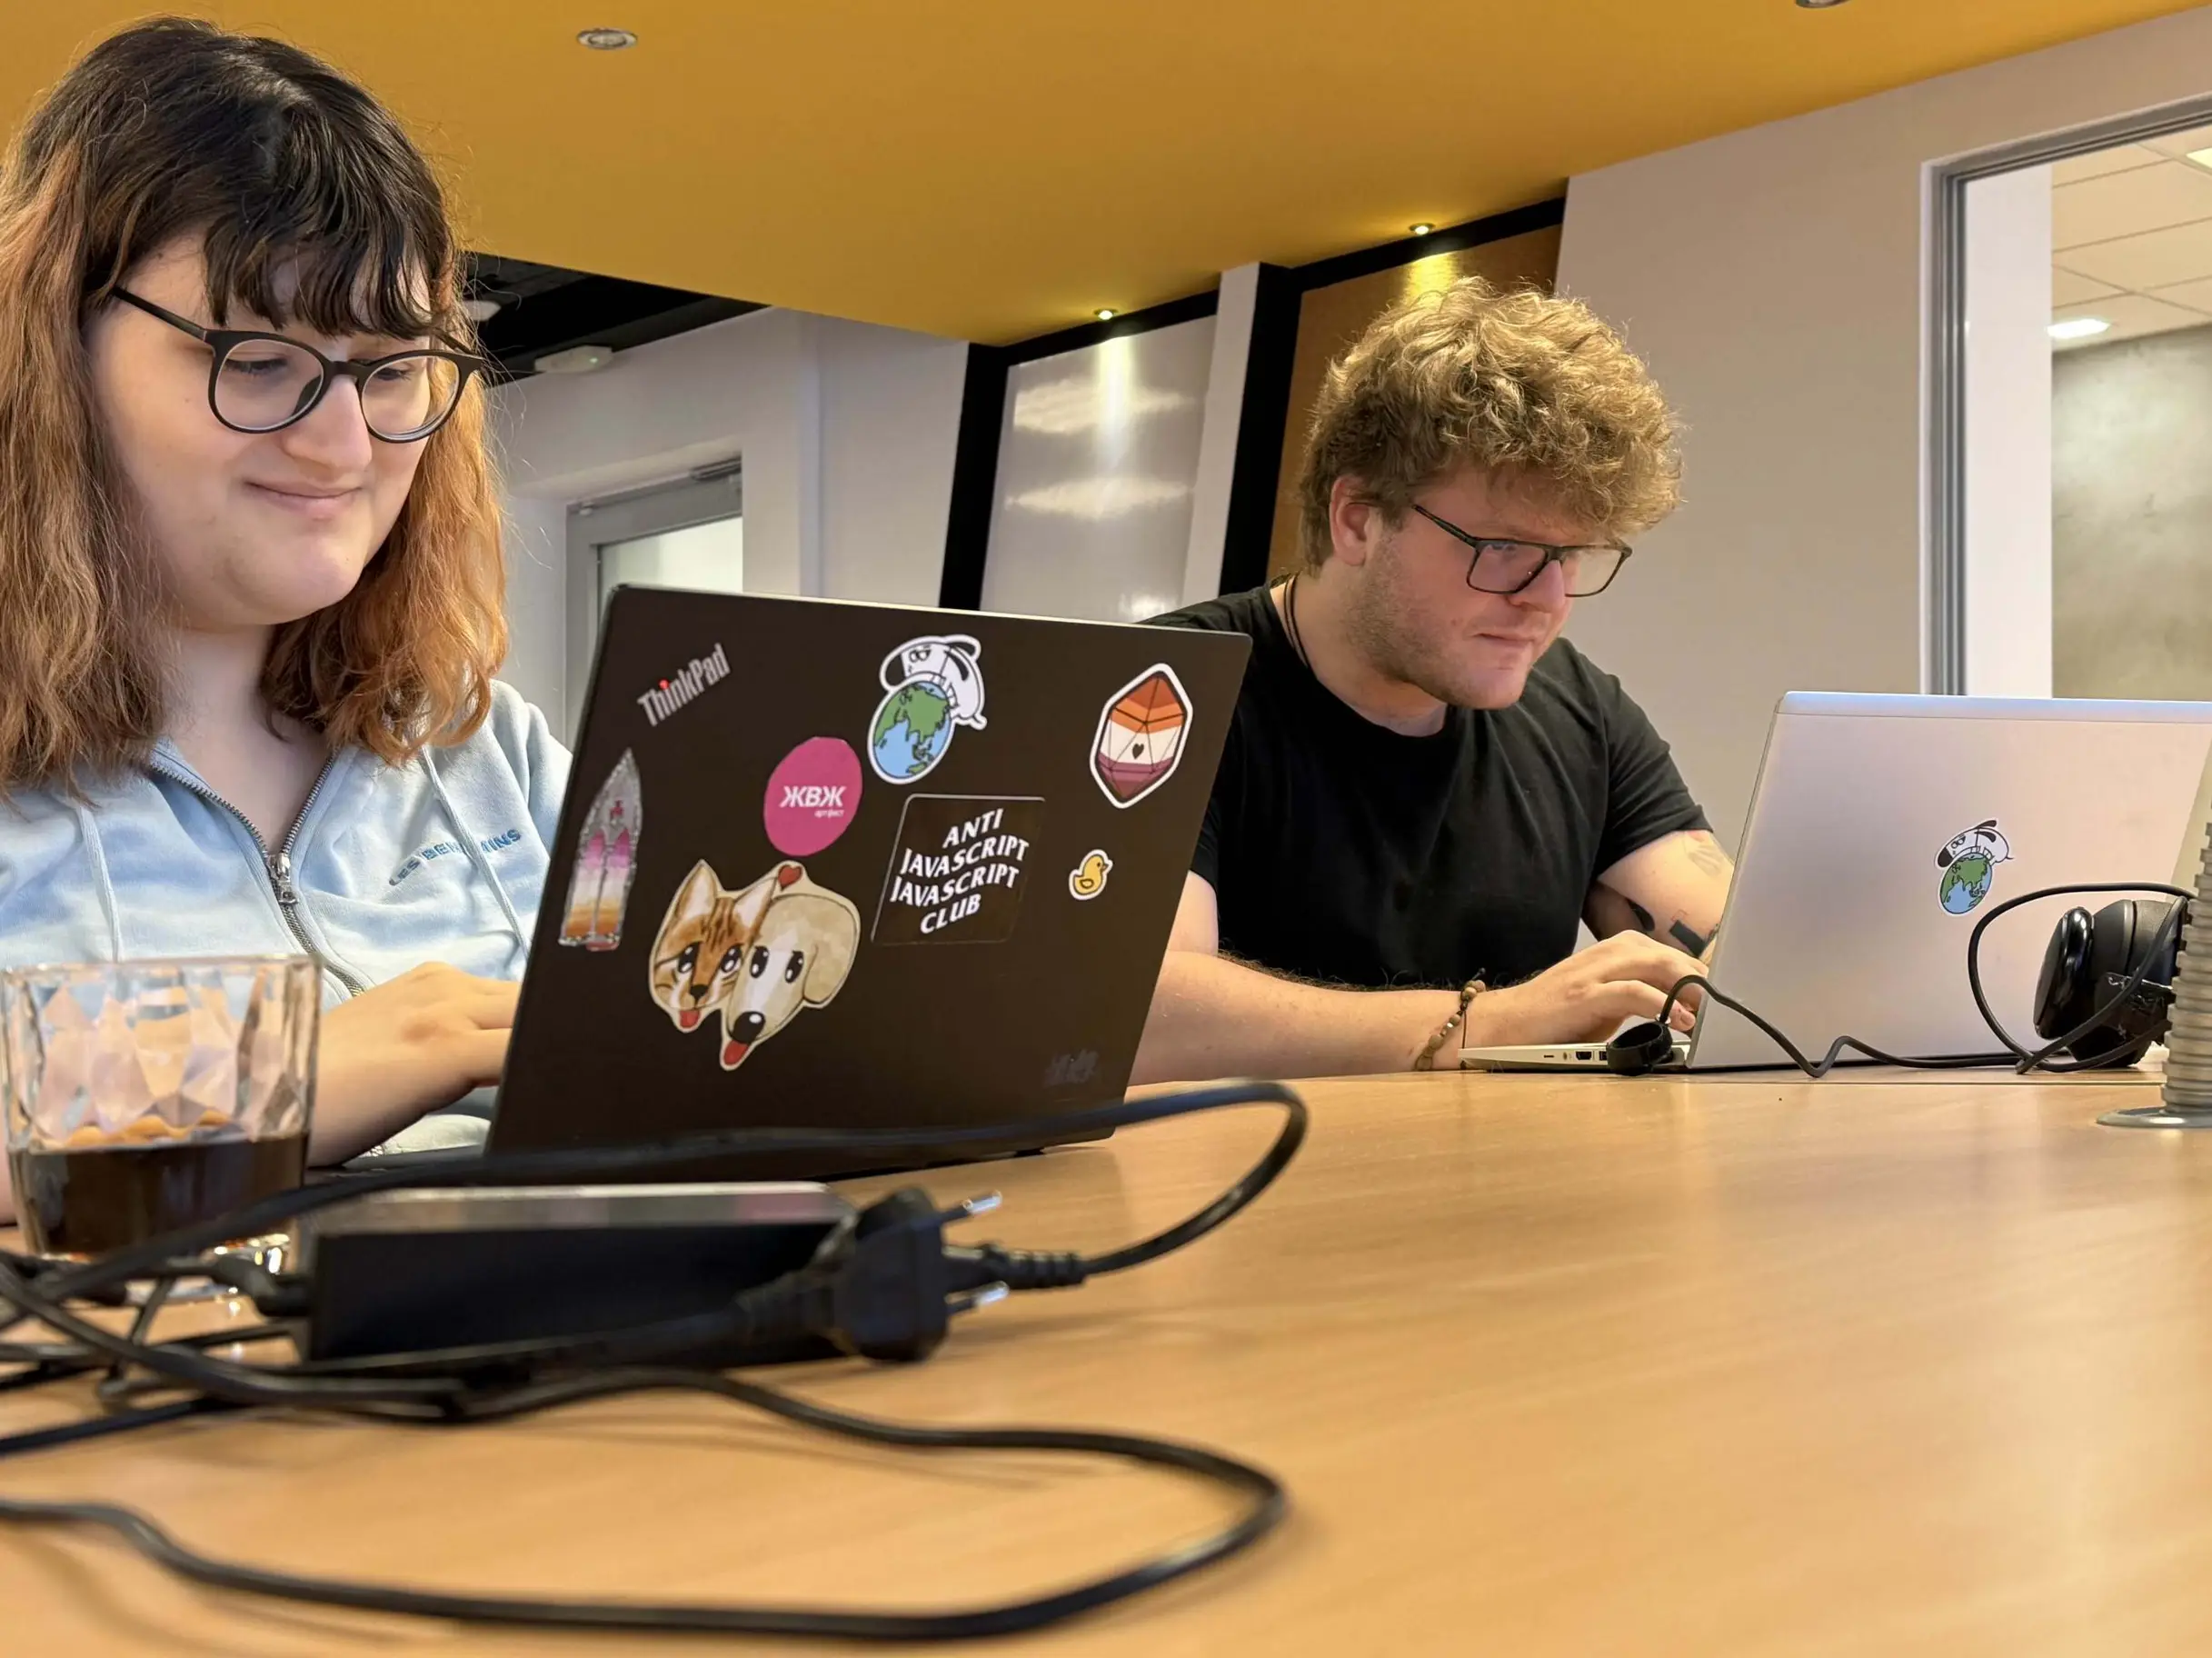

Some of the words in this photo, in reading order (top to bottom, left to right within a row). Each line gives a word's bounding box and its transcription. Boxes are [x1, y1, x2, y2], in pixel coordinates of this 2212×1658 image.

[637, 643, 731, 727] ThinkPad
[779, 785, 847, 808] ЖВЖ
[942, 808, 1004, 849] ANTI
[900, 834, 1030, 879] JAVASCRIPT
[890, 863, 1020, 907] JAVASCRIPT
[920, 894, 981, 934] CLUB
